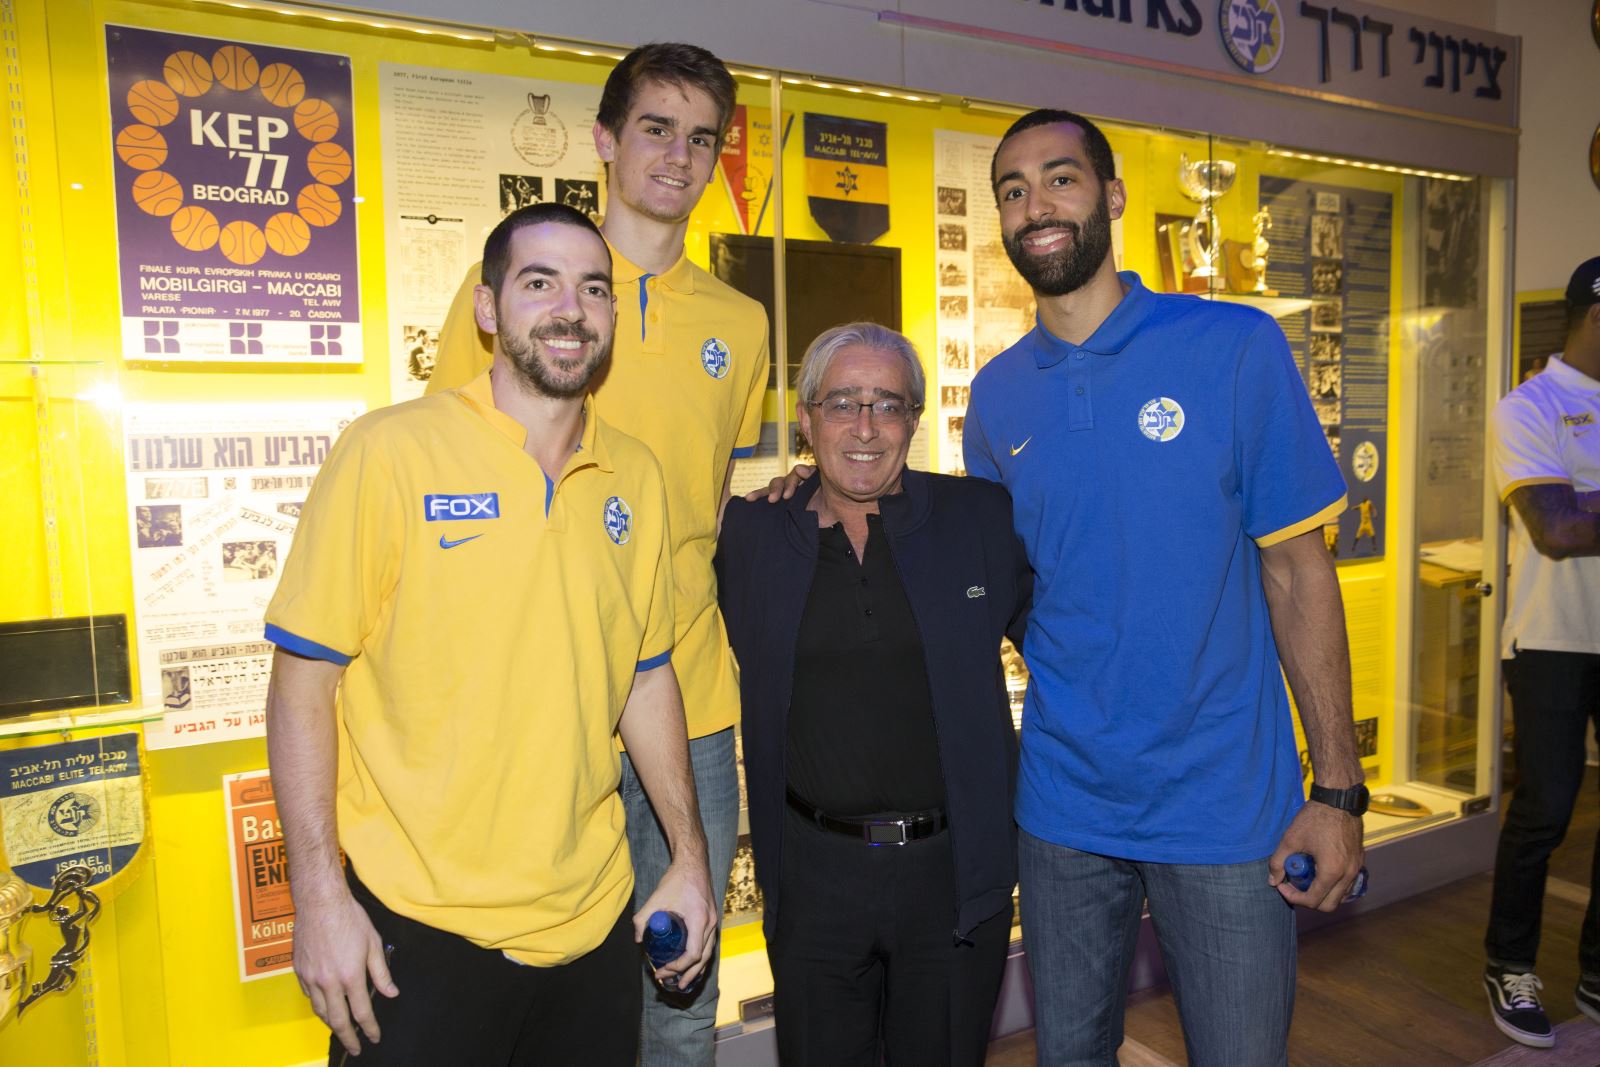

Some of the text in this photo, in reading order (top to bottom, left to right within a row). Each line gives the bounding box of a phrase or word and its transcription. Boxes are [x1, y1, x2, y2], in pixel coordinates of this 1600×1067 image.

[1297, 1, 1393, 83] דרך
[1409, 27, 1507, 100] ציוני
[190, 109, 289, 152] KEP
[229, 150, 289, 190] '77
[192, 184, 290, 206] BEOGRAD
[139, 264, 341, 281] FINALE KUPA EVROPSKIH PRVAKA U KOŠARCI
[140, 277, 247, 294] MOBILGIRGI
[267, 282, 341, 298] MACCABI
[141, 292, 182, 302] VARESE
[142, 306, 176, 314] PALATA
[307, 309, 342, 319] ČASOVA
[302, 298, 341, 307] TEL AVIV
[131, 435, 331, 470] הגביע הוא שלנו!
[430, 497, 493, 517] FOX
[174, 720, 216, 734] הגביע
[223, 716, 241, 728] על
[10, 750, 128, 778] מכבי עלית תל-אביב
[12, 773, 55, 790] MACCABI
[59, 768, 85, 781] ELITE
[56, 855, 104, 873] ISRAEL
